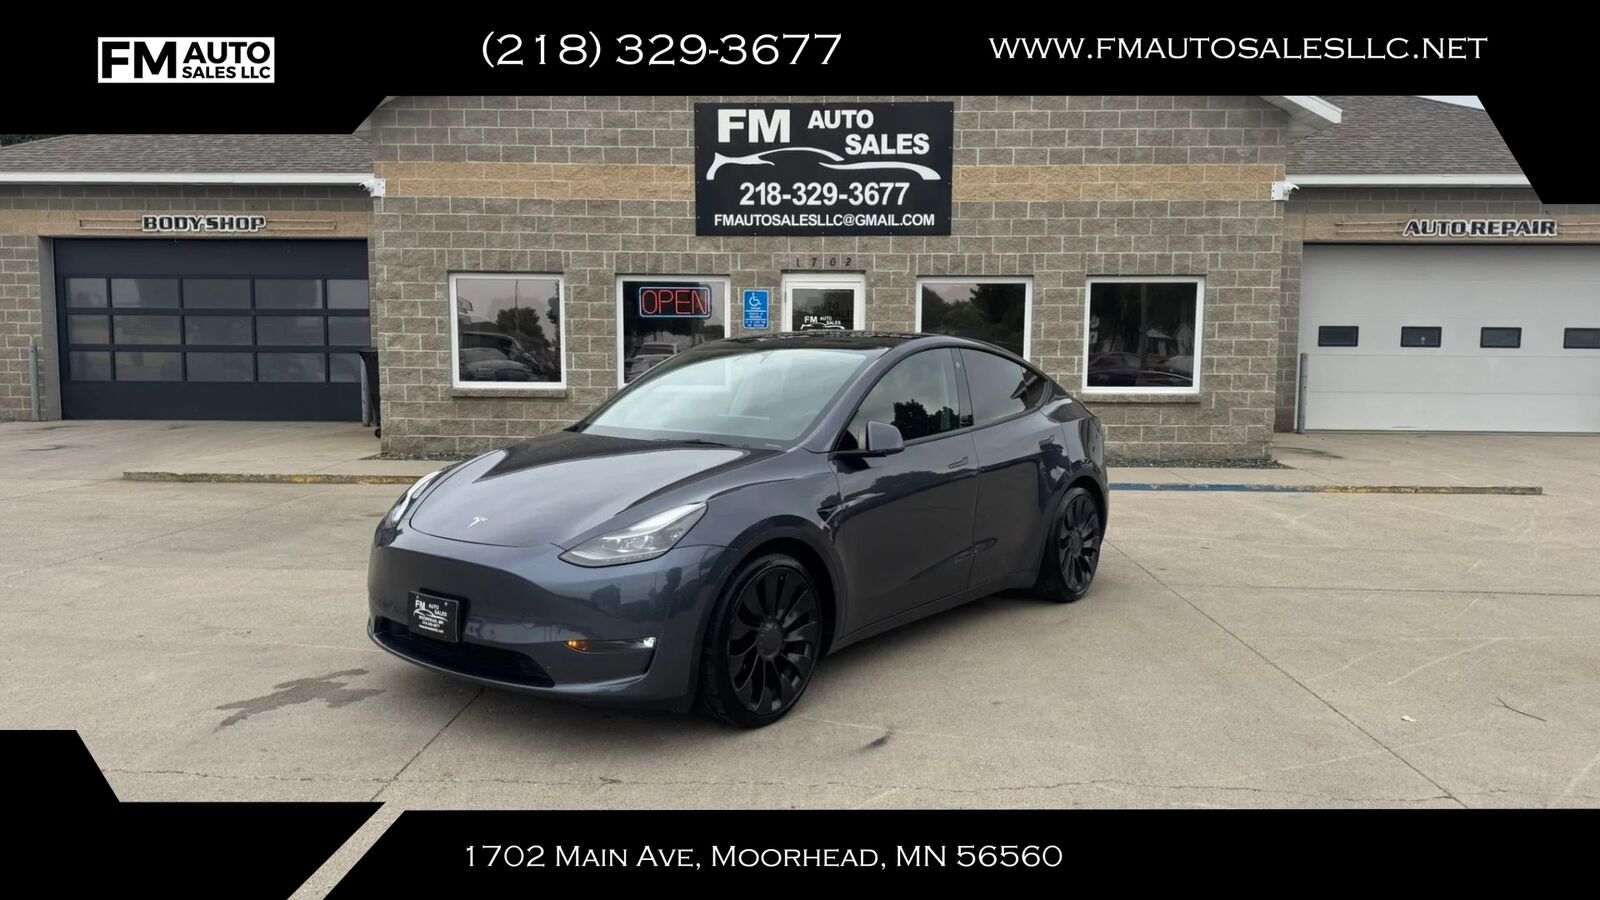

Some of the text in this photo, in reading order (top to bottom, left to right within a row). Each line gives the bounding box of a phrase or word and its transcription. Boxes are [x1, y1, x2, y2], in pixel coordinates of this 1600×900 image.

[718, 109, 873, 143] FM AUTO
[845, 133, 929, 155] SALES
[740, 182, 909, 206] 218-329-3677
[142, 215, 266, 231] BODY SHOP
[714, 214, 935, 227] FMAUTOSALESLLC@GMAIL.COM
[1403, 219, 1557, 236] AUTO REPAIR
[642, 290, 707, 314] OPEN
[415, 600, 426, 609] FM
